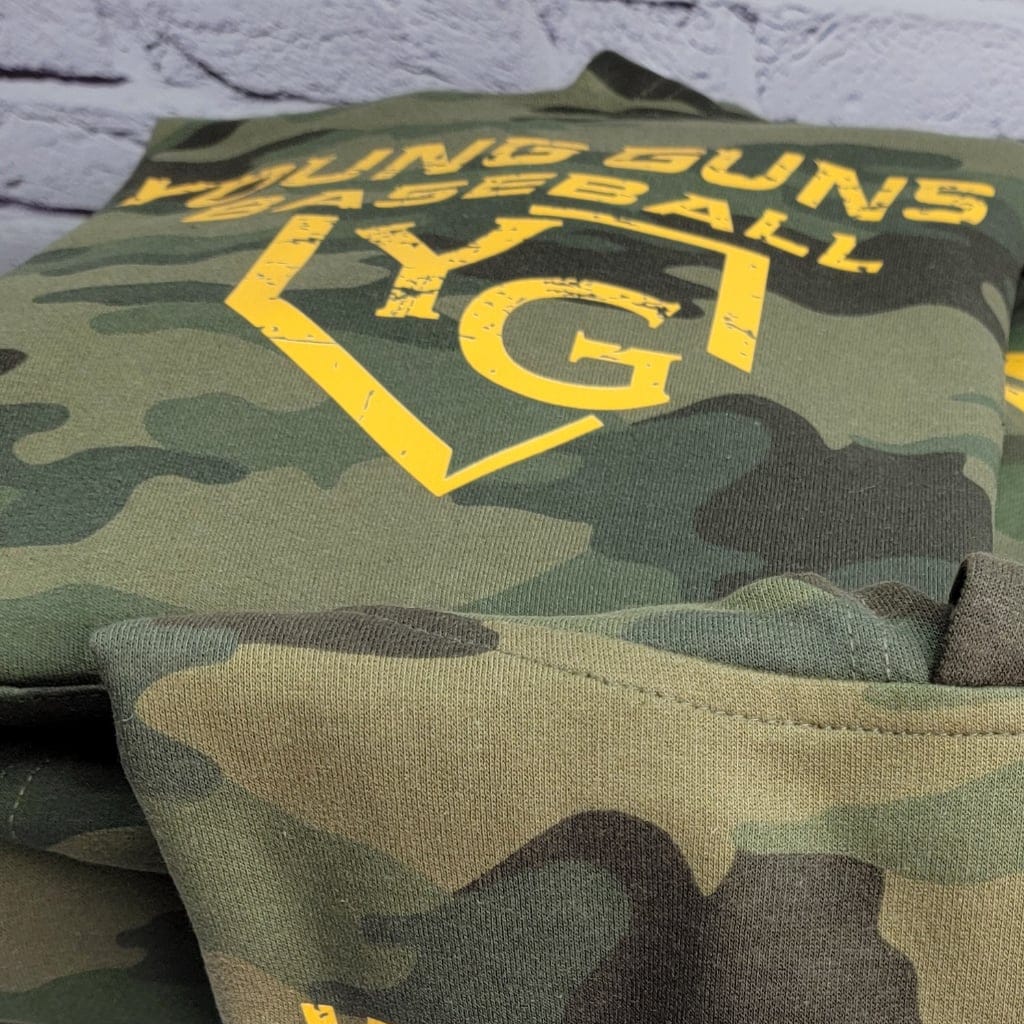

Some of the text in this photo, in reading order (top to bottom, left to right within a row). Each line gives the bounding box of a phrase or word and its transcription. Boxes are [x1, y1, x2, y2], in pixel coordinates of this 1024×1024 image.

[120, 136, 996, 226] YOUNG GUNS
[180, 172, 885, 274] BASEBALL
[355, 216, 683, 412] YG
